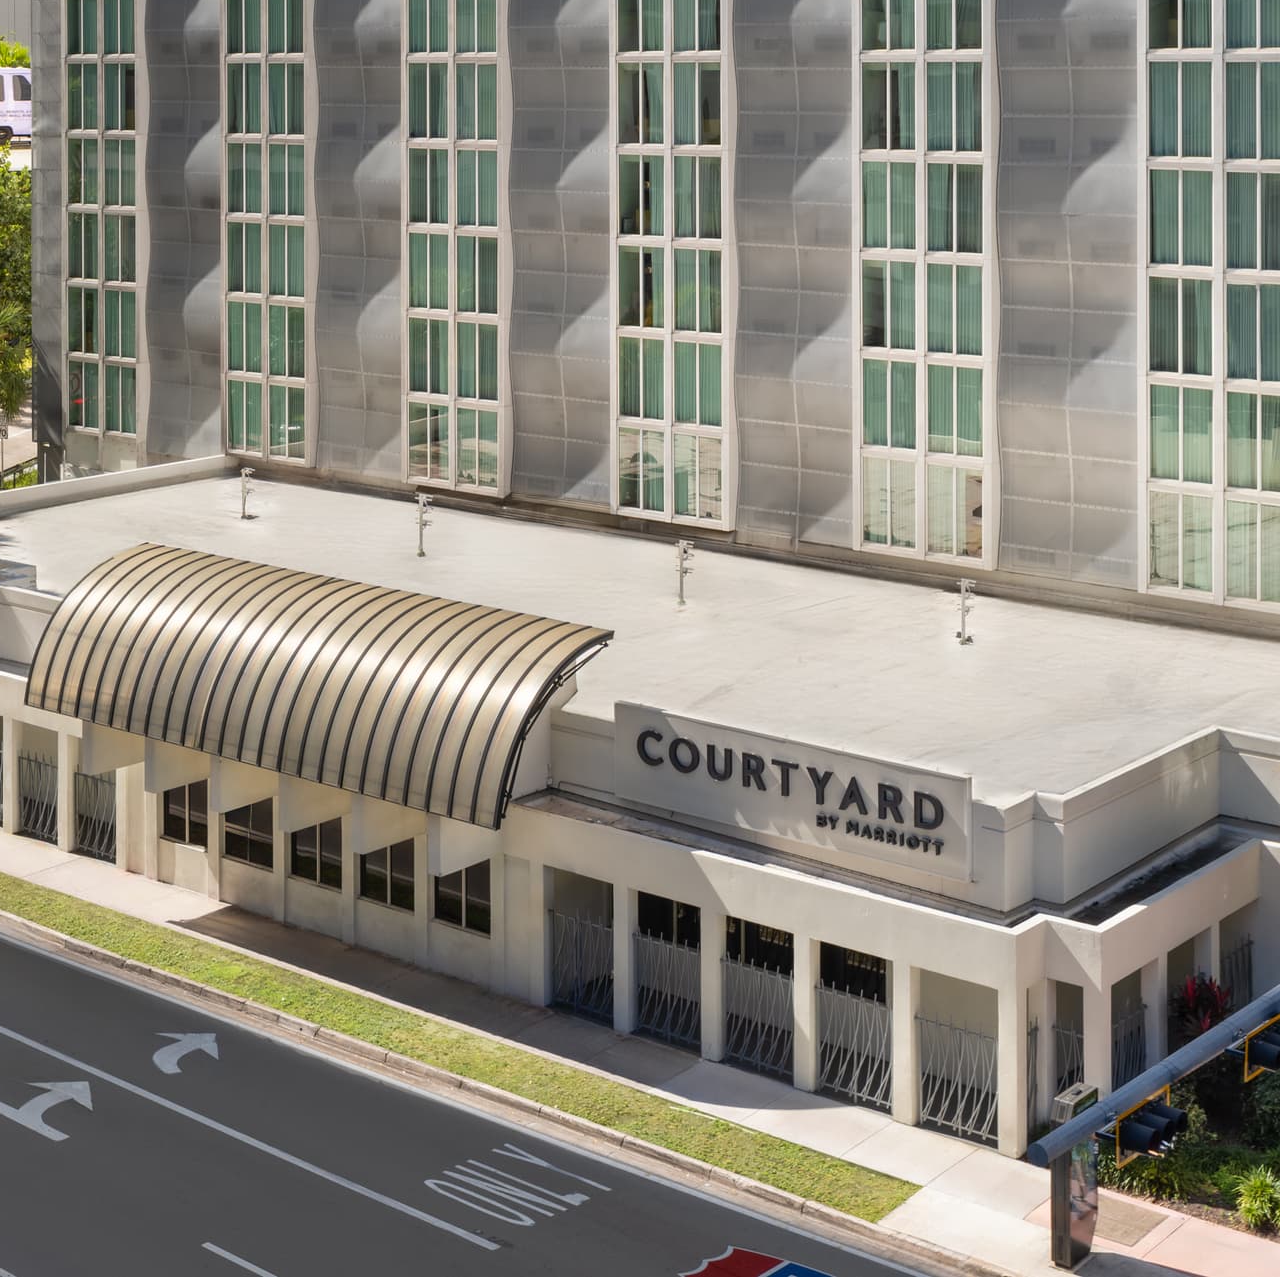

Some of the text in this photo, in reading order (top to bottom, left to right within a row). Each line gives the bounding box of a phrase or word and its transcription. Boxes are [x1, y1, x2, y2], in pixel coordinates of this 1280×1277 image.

[636, 729, 945, 831] COURTYARD
[816, 812, 945, 857] BY MARRIOTT
[424, 1143, 612, 1226] ONLY
